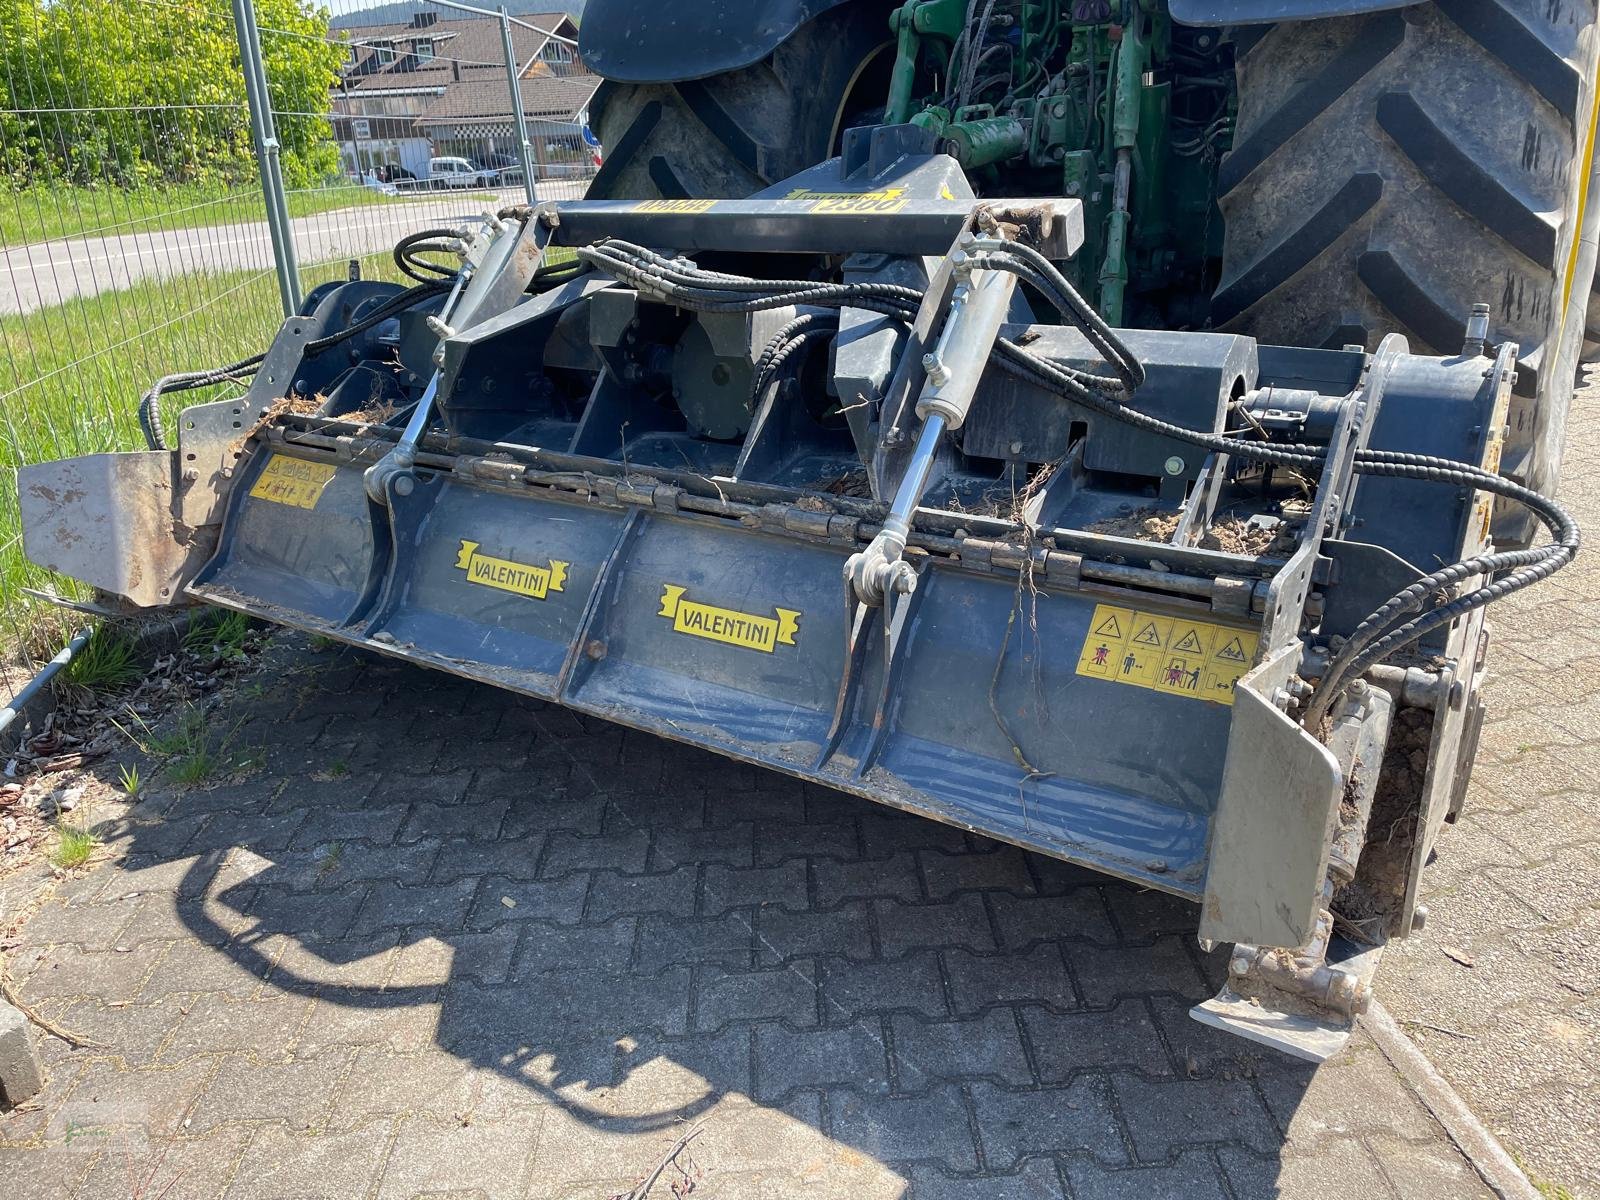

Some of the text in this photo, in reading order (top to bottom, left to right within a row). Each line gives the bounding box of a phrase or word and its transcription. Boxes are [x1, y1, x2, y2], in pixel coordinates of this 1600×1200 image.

[818, 199, 898, 211] 2300
[474, 561, 544, 592] VALENTINI
[683, 608, 769, 644] VALENTINI
